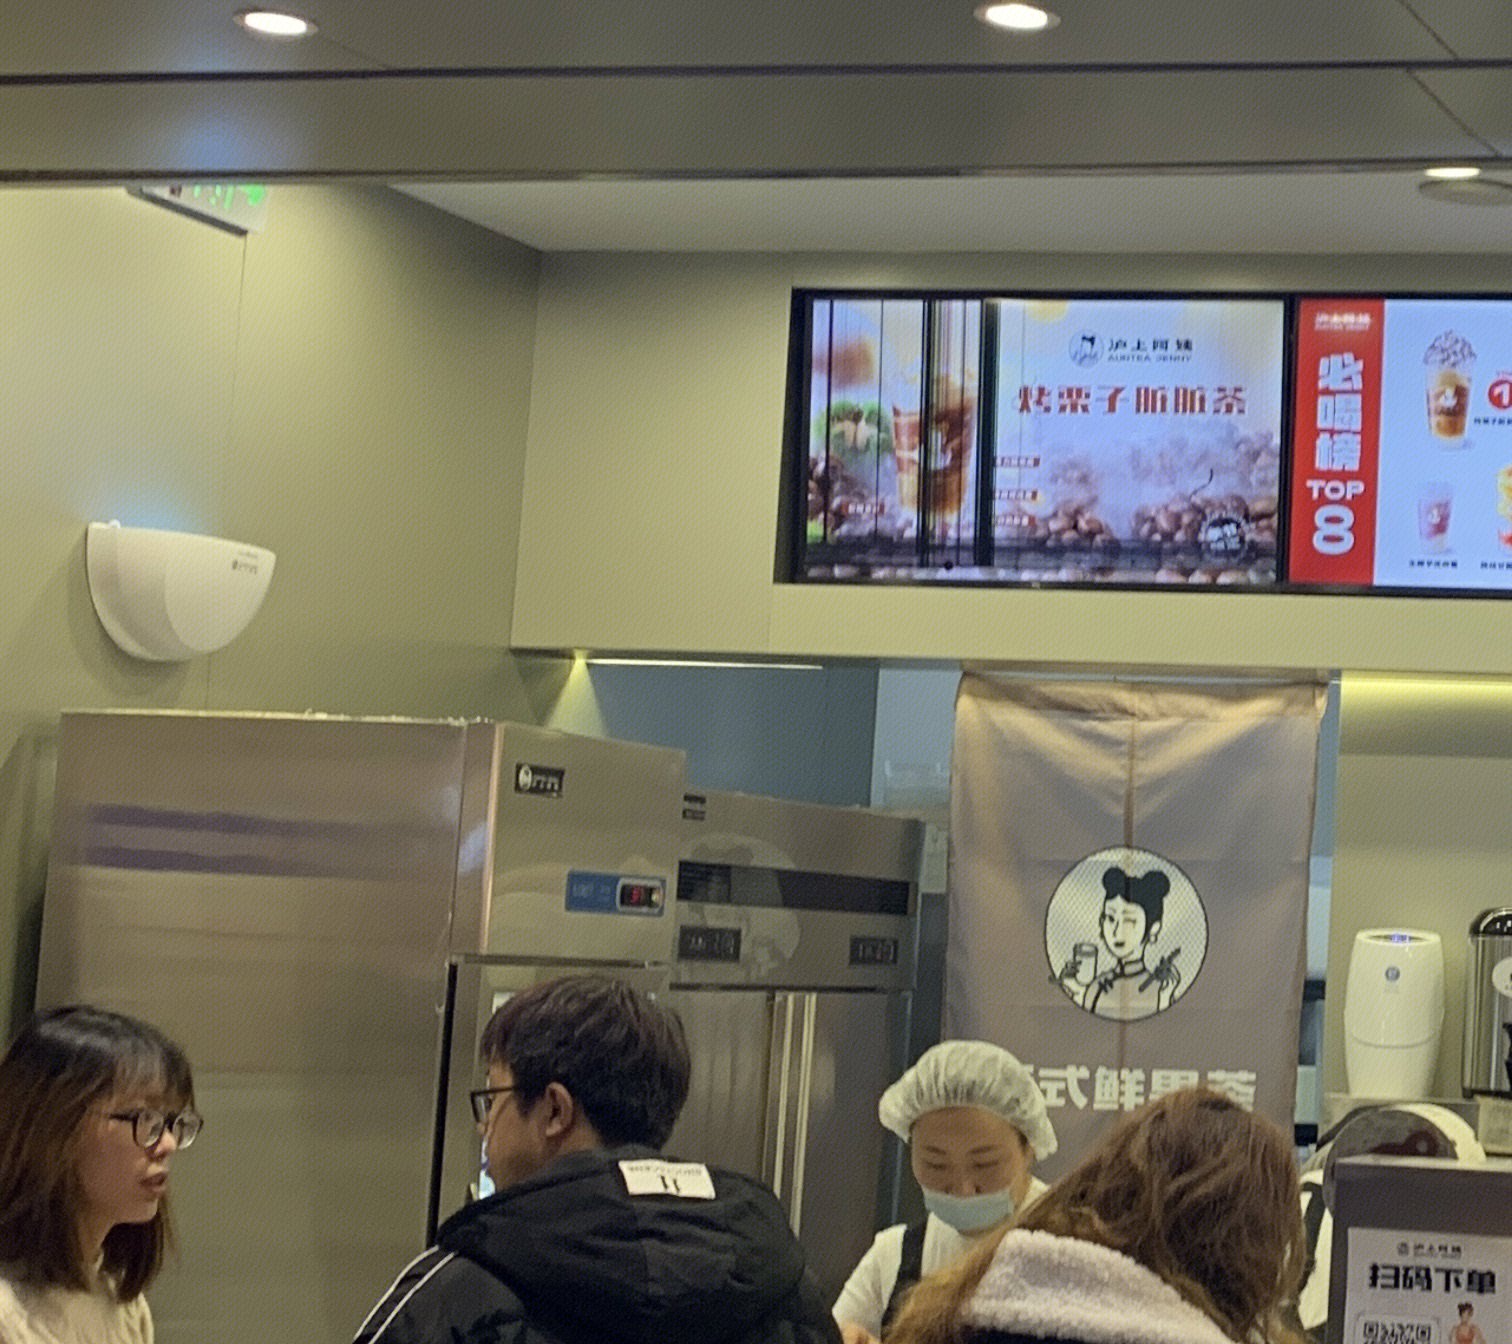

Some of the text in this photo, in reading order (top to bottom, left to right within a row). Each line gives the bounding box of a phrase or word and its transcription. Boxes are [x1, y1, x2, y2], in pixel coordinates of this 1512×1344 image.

[1107, 338, 1193, 352] 沪上阿姨
[1306, 479, 1366, 500] TOP
[1312, 503, 1355, 555] 8
[1020, 1064, 1256, 1112] 式鲜果茶
[1369, 1262, 1496, 1295] 扫码下单
